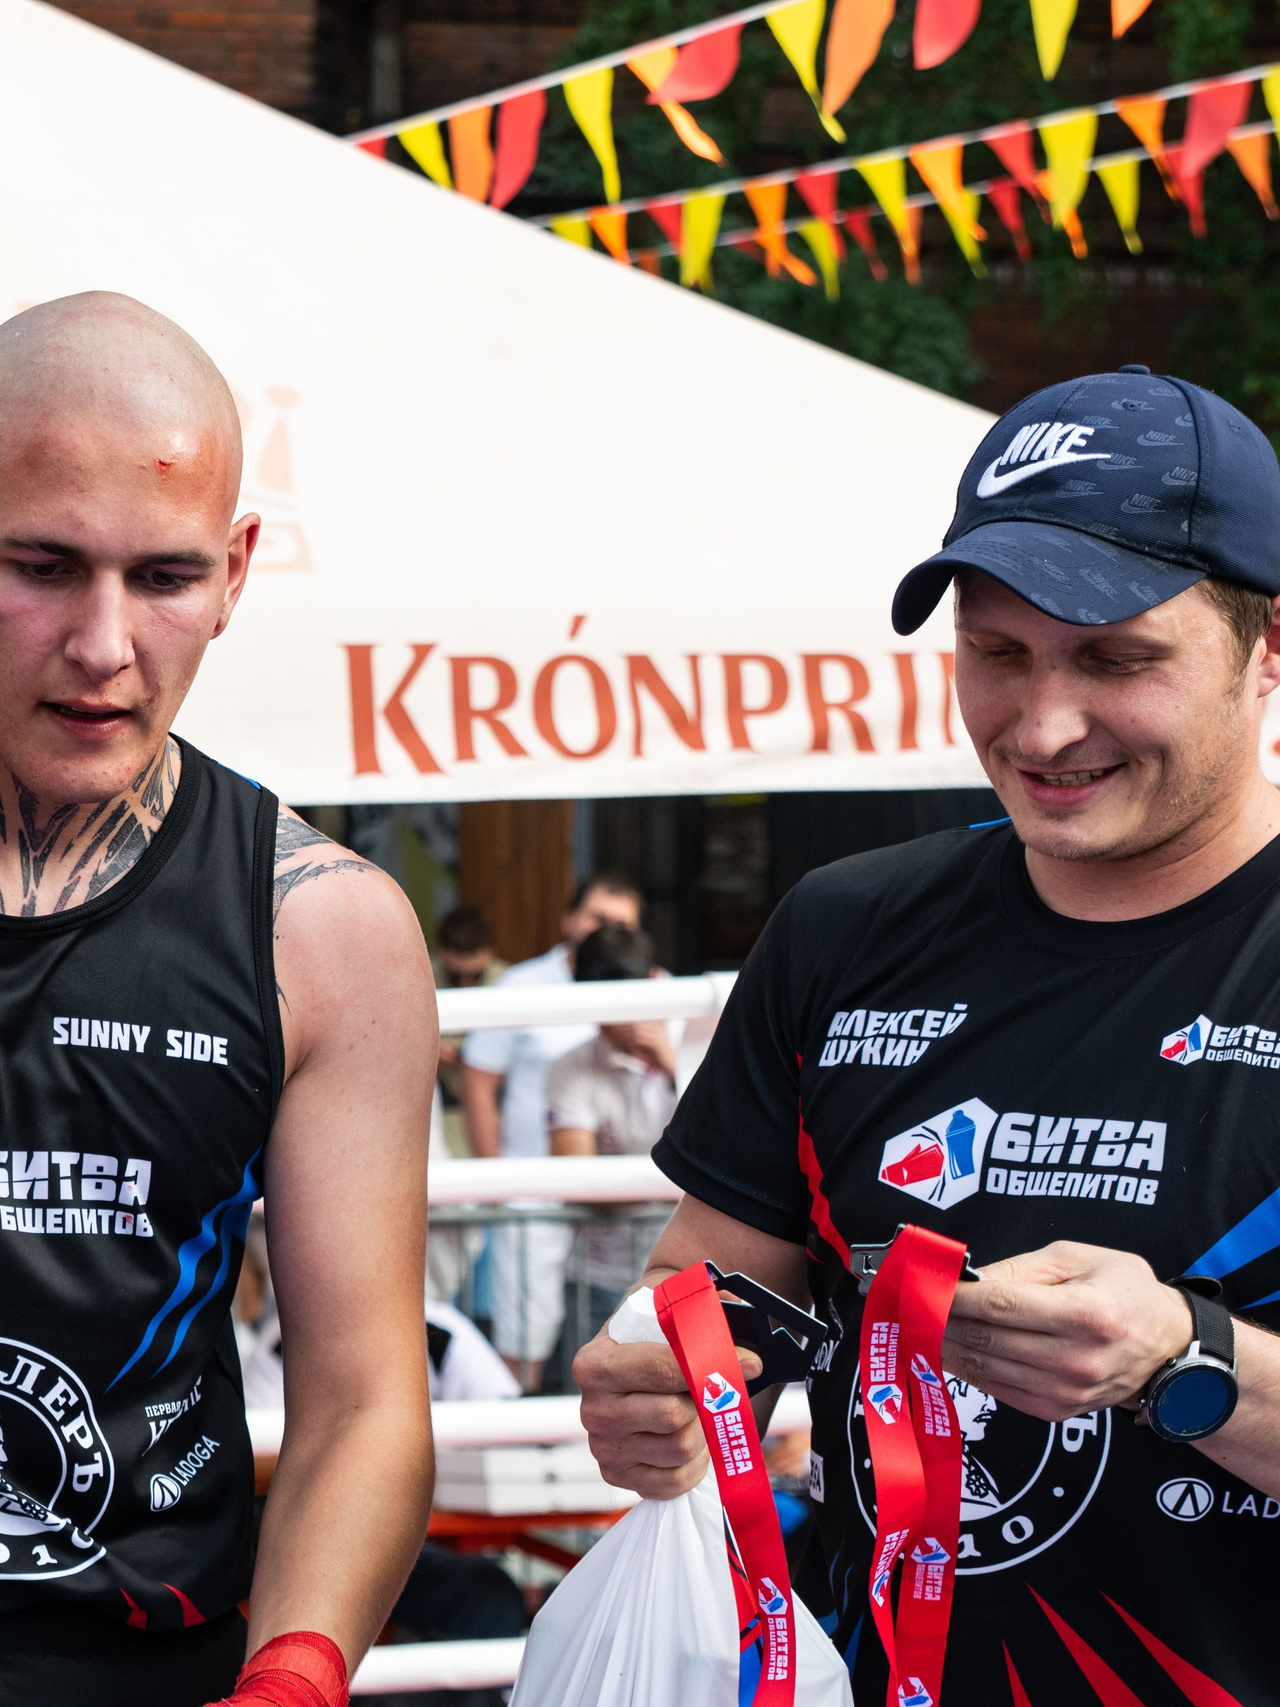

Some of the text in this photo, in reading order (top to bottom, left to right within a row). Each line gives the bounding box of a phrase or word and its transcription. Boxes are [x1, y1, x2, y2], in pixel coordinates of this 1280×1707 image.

[999, 422, 1095, 467] NIKE
[53, 1016, 228, 1066] SUNNY SIDE
[827, 1003, 968, 1038] АЛЕКСЕЙ
[990, 1112, 1168, 1172] БИТВА
[985, 1167, 1159, 1206] ОБЩЕПИТОВ
[870, 1322, 890, 1382] БИТВА
[887, 1323, 900, 1381] ОБЩЕПИТОВ
[929, 1386, 952, 1437] БИТВА
[169, 1434, 221, 1487] LADOGA
[713, 1415, 736, 1477] ОБЩЕПИТОВ
[724, 1410, 753, 1474] БИТВА
[775, 1617, 788, 1680] БИТВА
